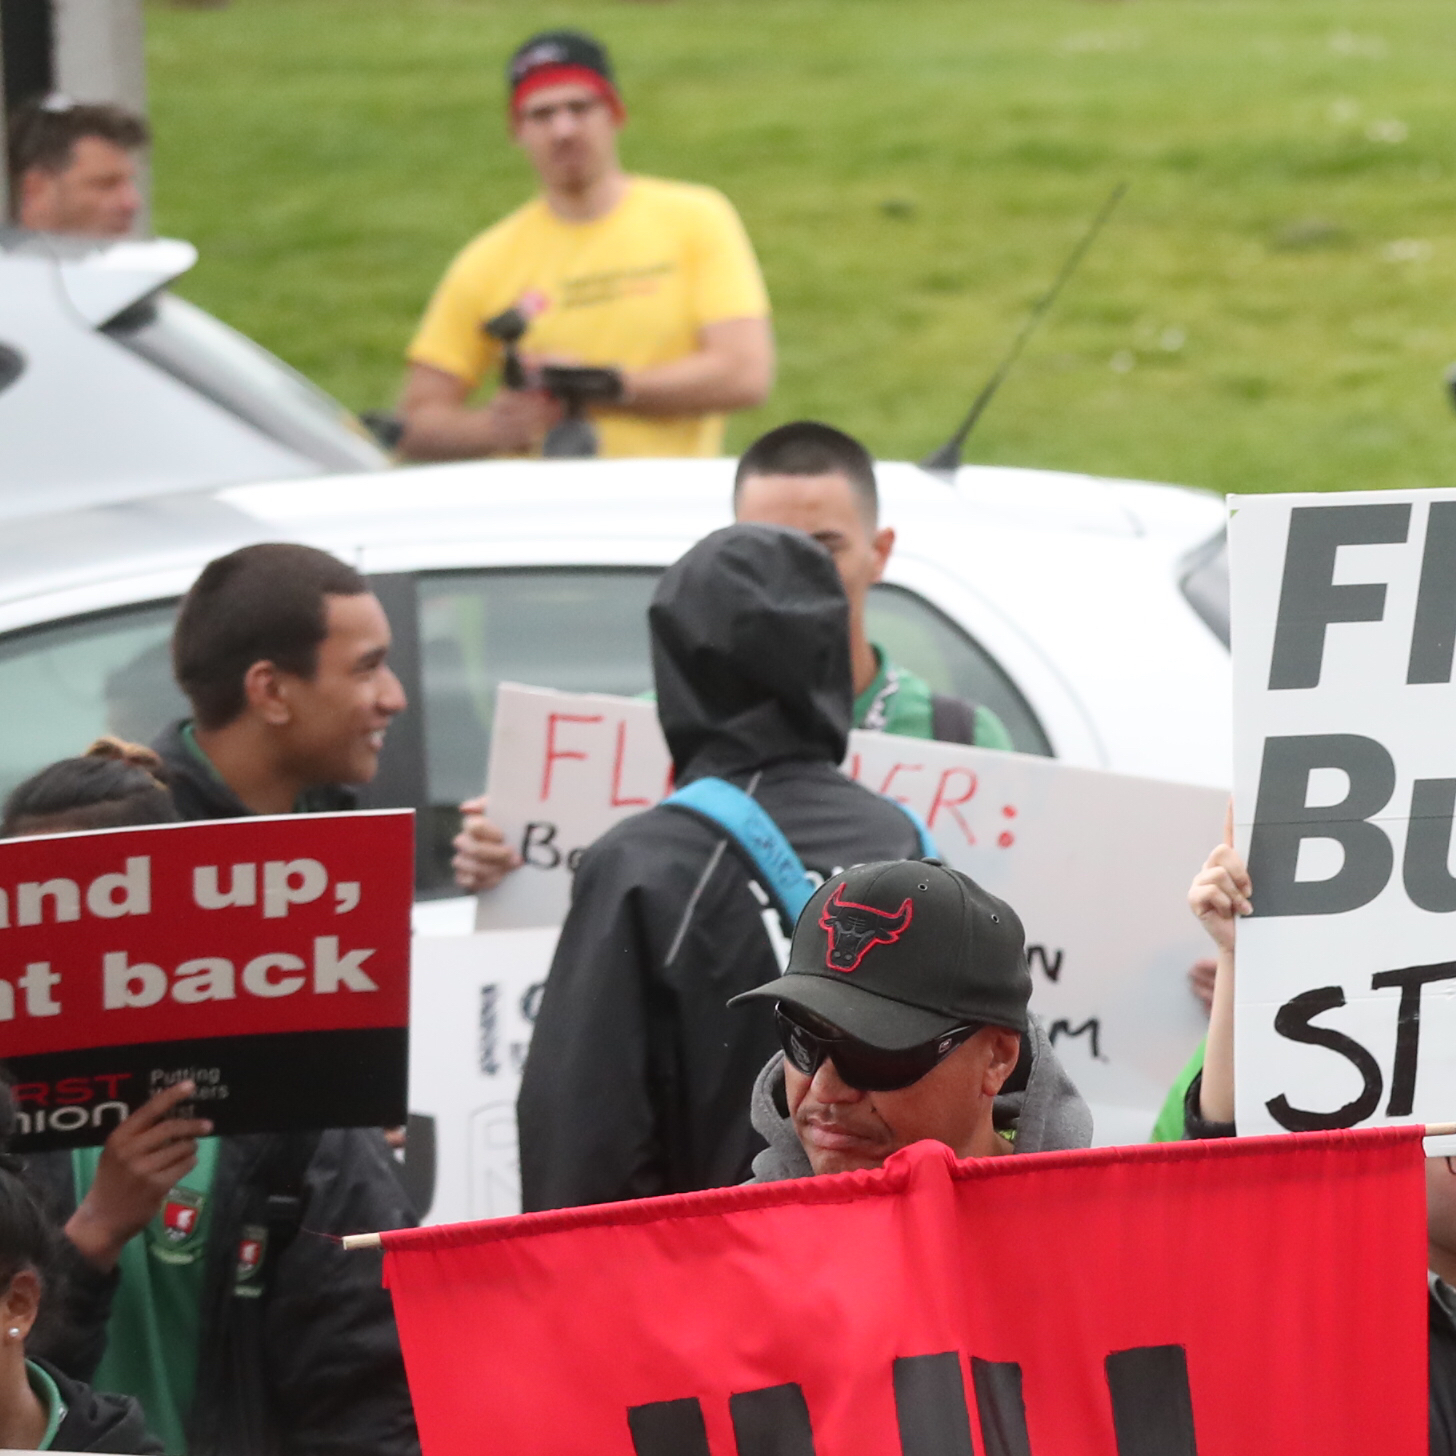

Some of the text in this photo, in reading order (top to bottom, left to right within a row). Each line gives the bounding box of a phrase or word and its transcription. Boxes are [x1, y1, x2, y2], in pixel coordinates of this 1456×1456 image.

[193, 857, 361, 919] up,
[103, 935, 379, 1010] back
[10, 1073, 132, 1106] RST
